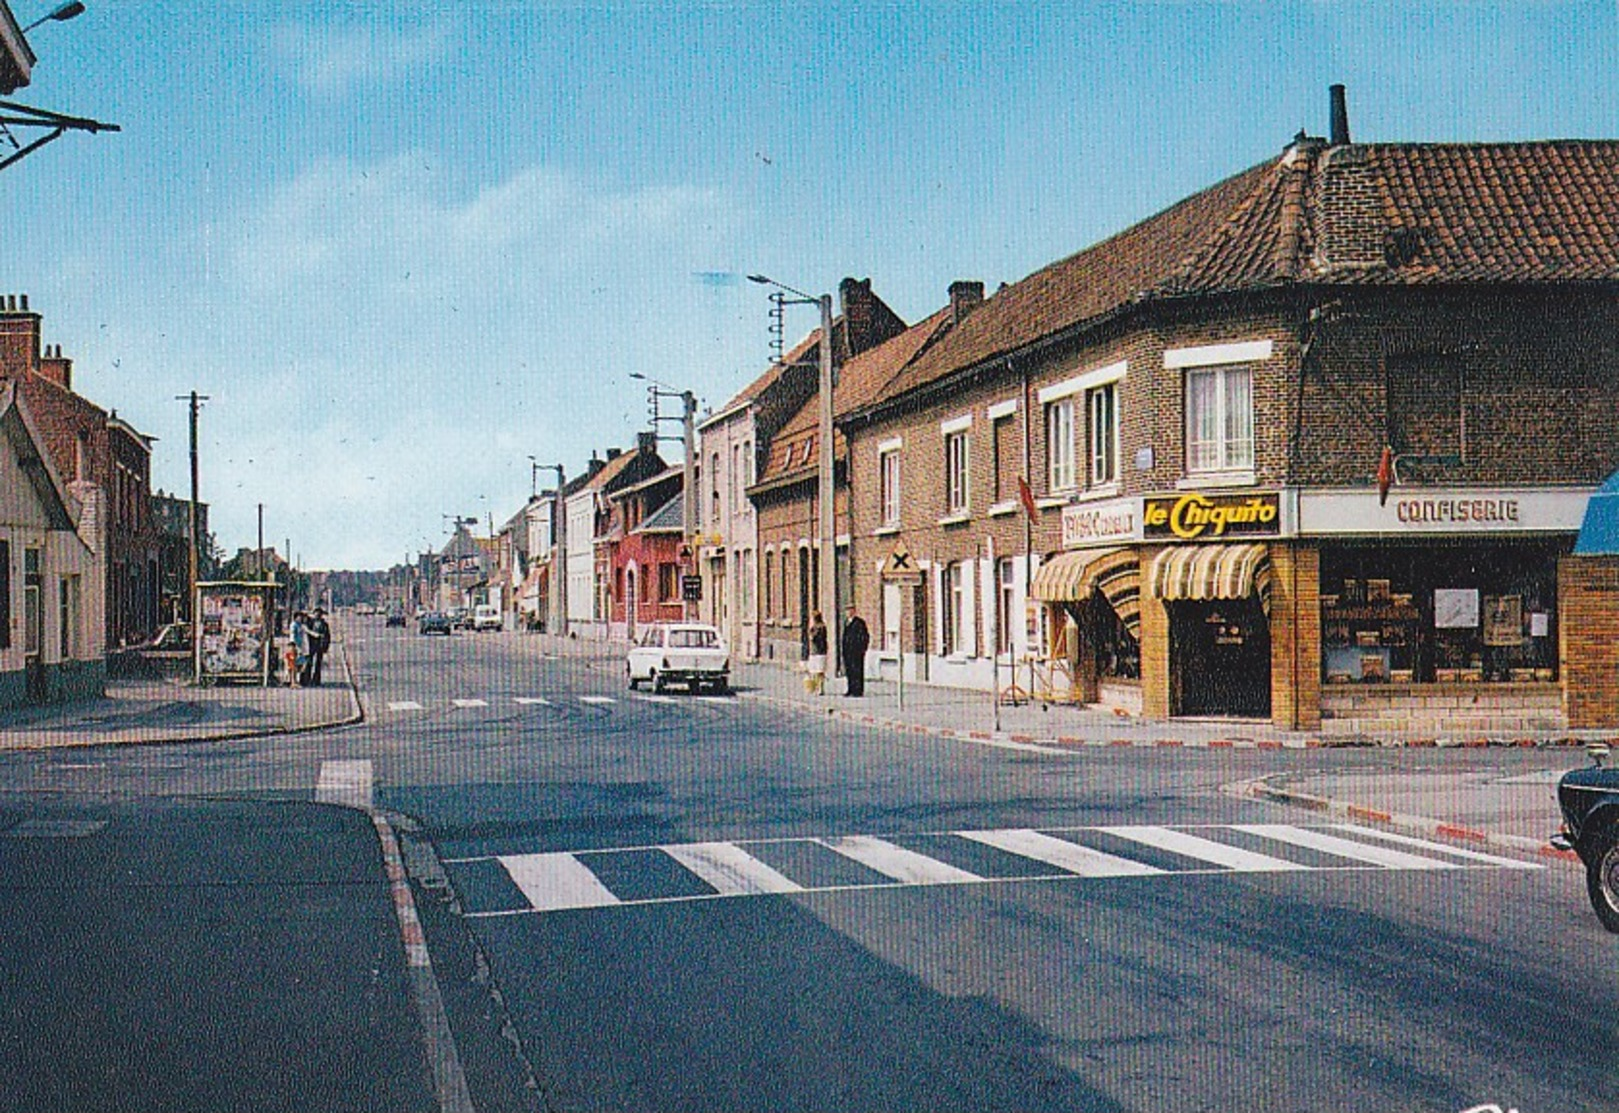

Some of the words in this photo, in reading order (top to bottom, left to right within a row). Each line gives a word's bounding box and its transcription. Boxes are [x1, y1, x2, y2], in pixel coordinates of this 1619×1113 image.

[1143, 503, 1168, 526] le
[1170, 494, 1276, 538] Chiquito
[1397, 500, 1519, 522] CONFISERIE
